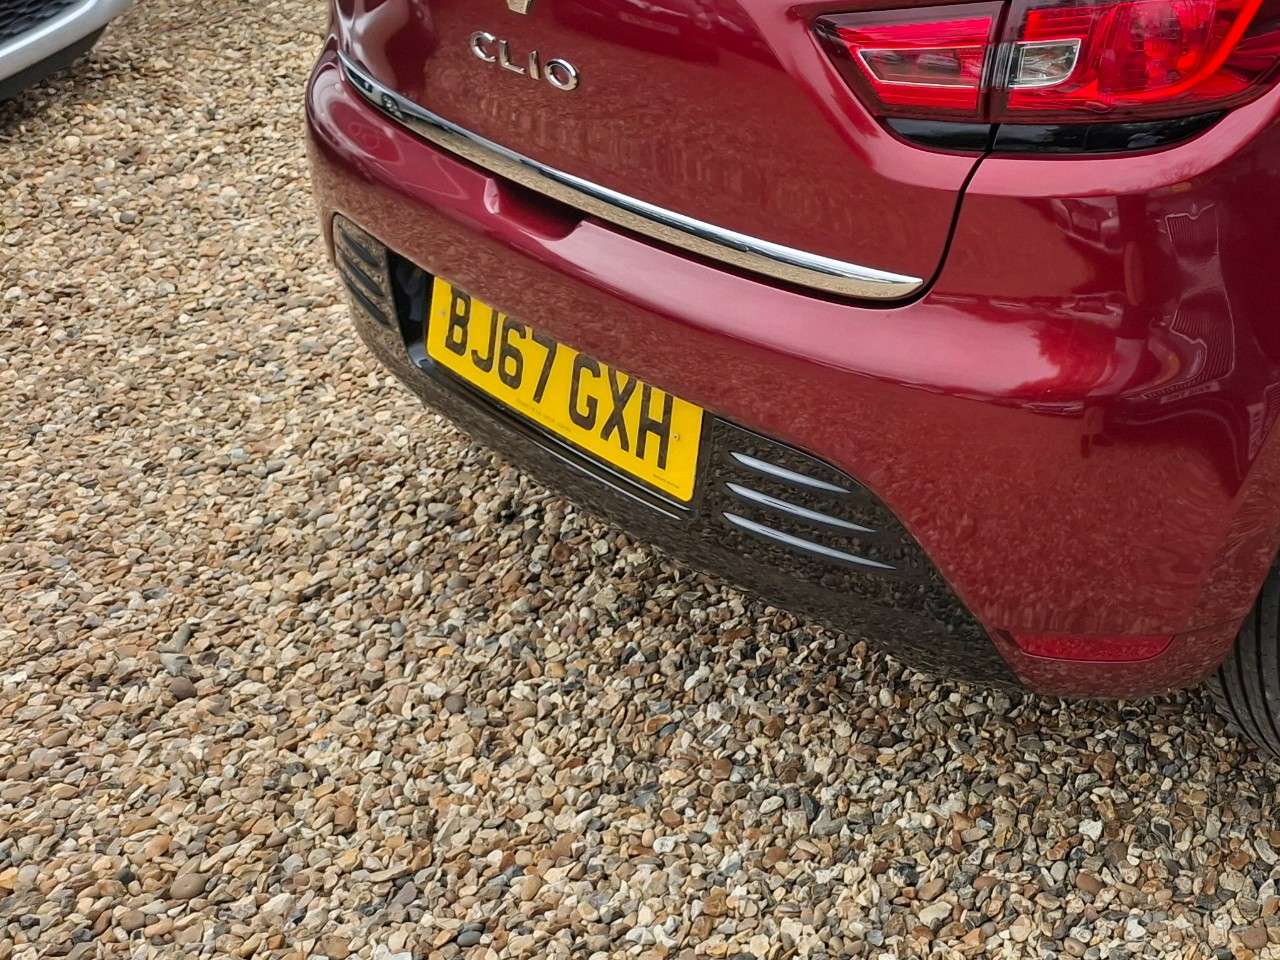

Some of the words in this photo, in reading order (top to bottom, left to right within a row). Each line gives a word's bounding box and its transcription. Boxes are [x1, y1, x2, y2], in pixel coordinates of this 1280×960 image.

[470, 30, 579, 91] CLIO
[444, 286, 558, 404] BJ67
[568, 353, 674, 471] GXH
